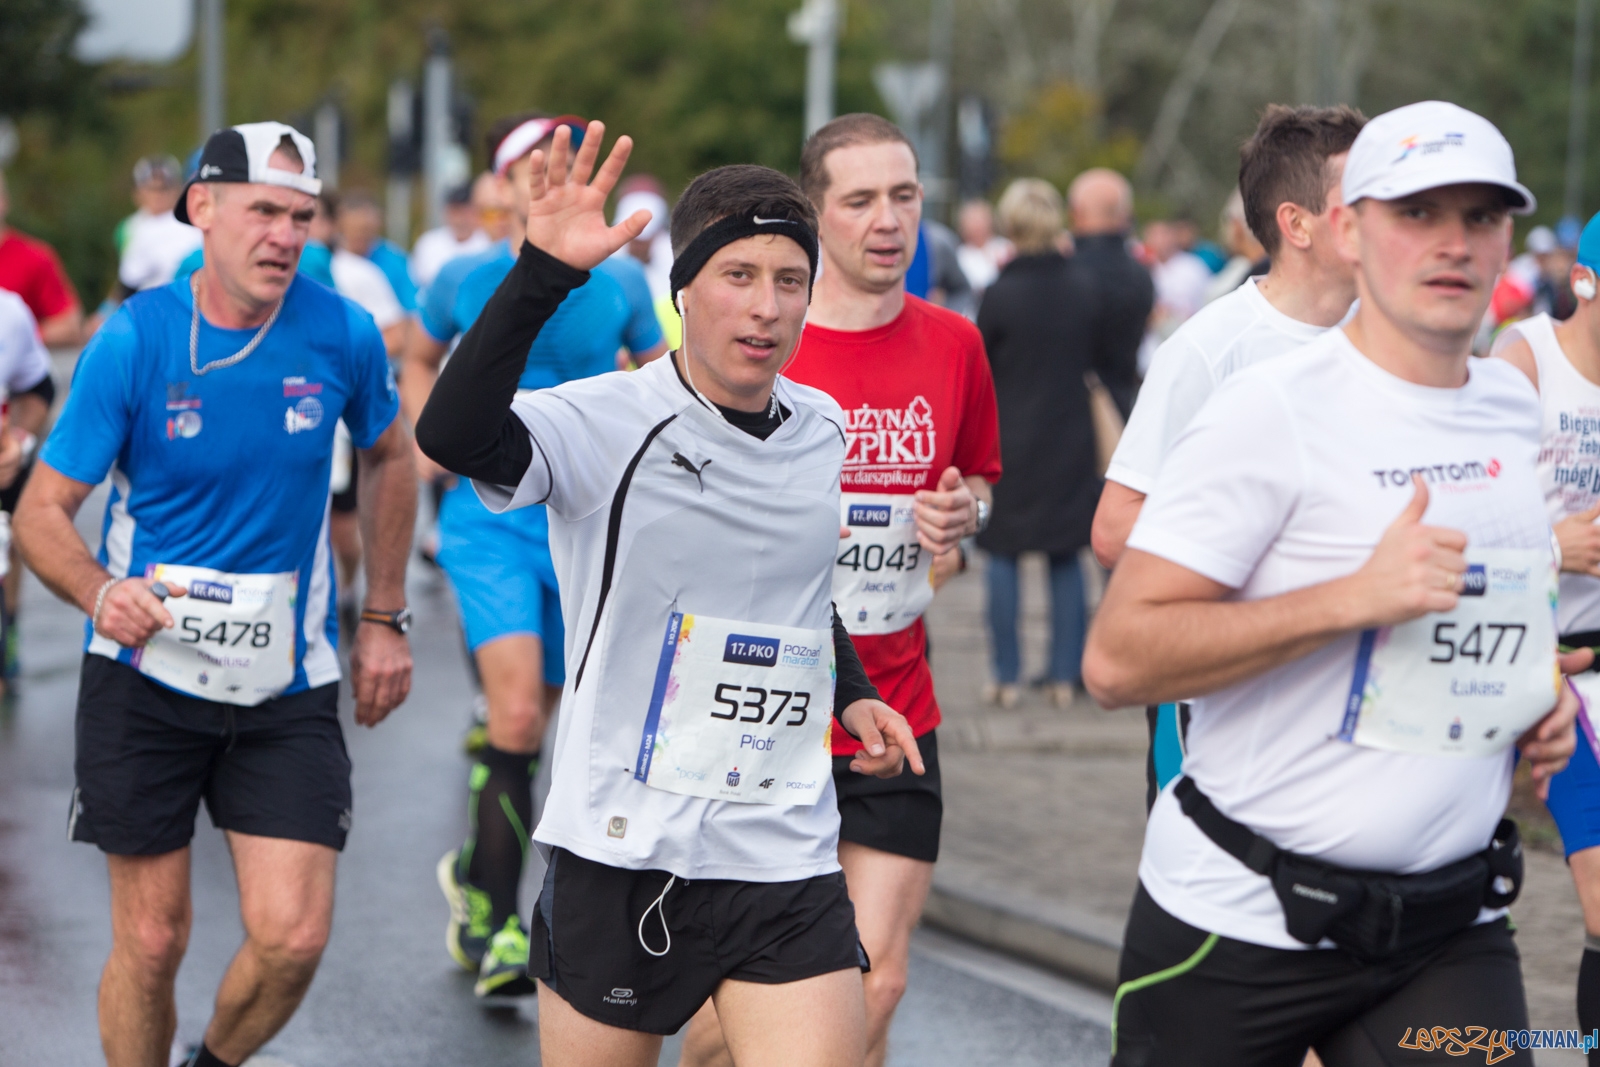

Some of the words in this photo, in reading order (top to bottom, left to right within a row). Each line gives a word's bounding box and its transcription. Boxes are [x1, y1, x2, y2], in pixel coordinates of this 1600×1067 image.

[1560, 411, 1600, 437] Biegn
[837, 543, 921, 572] 4043
[180, 616, 272, 648] 5478
[1429, 622, 1527, 665] 5477
[782, 655, 819, 666] maraton
[710, 682, 811, 727] 5373
[739, 733, 775, 751] Piotr
